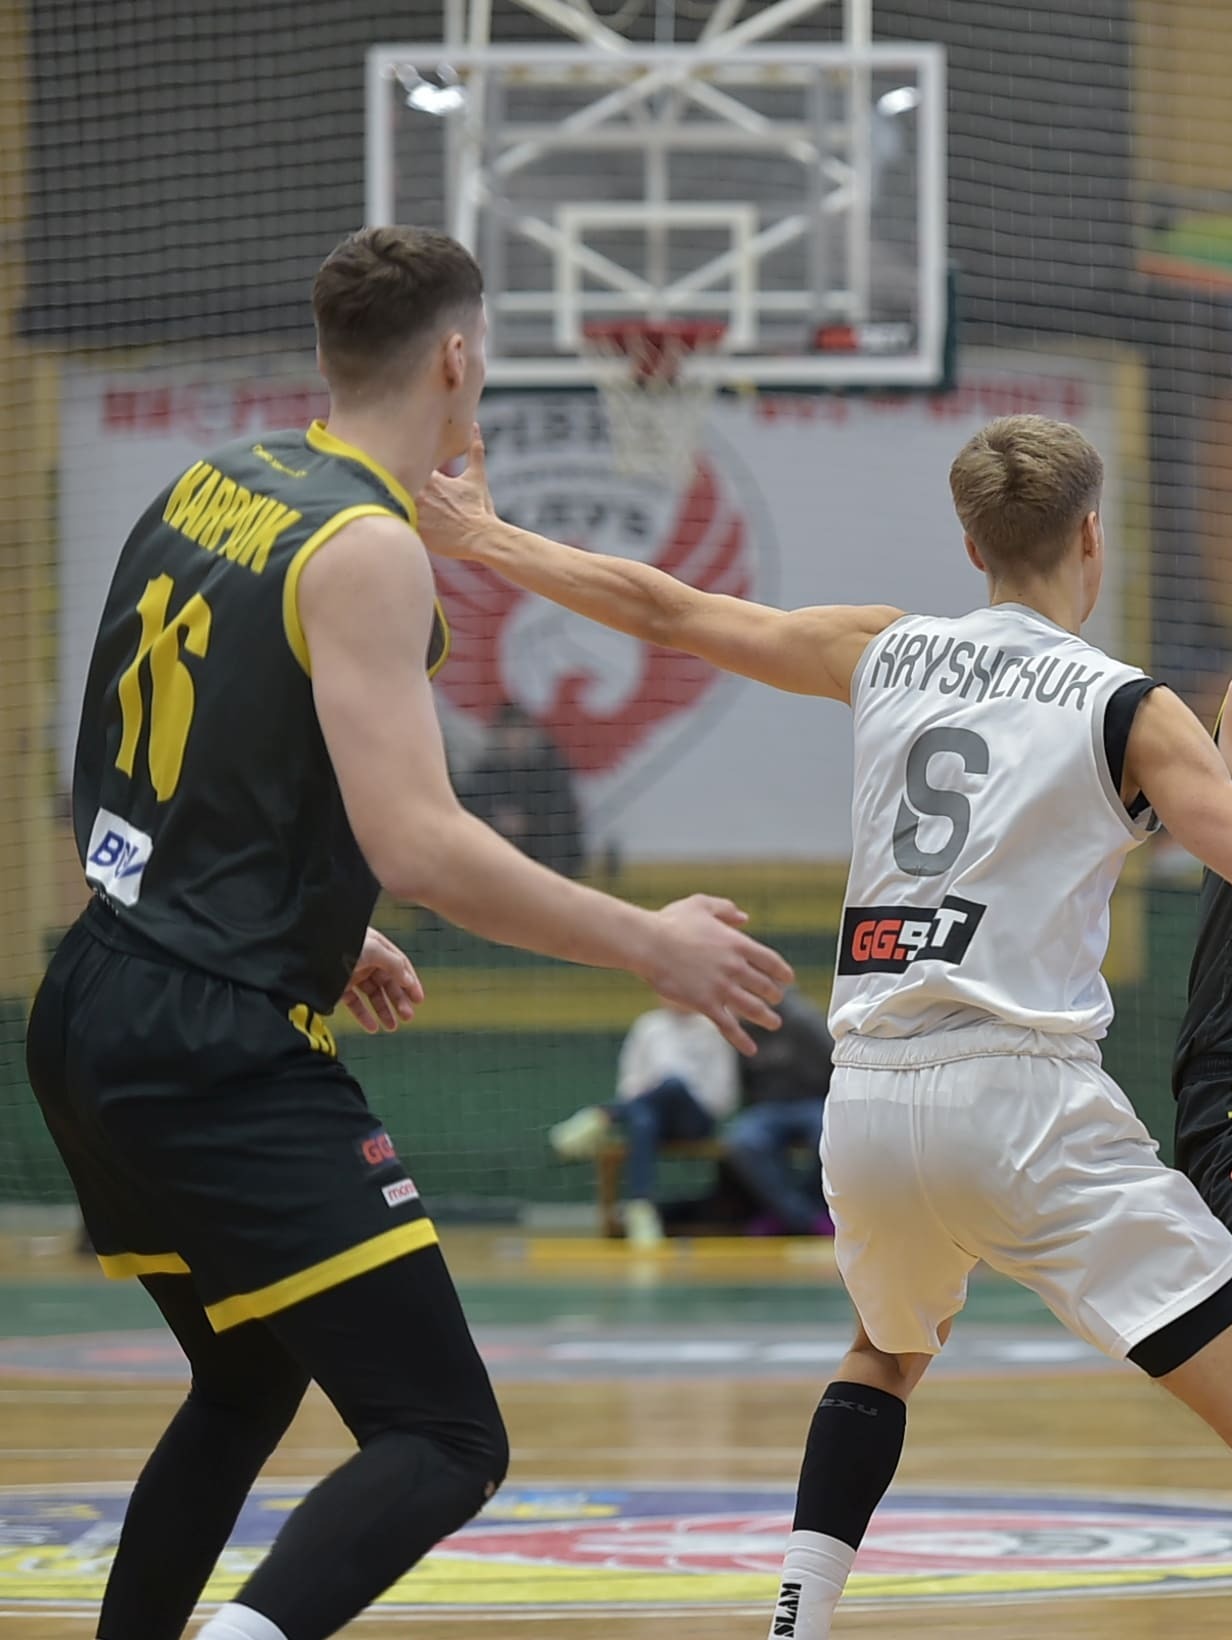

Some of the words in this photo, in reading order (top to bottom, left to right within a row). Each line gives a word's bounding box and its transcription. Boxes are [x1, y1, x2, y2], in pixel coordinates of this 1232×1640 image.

[114, 572, 212, 802] 16
[869, 633, 1104, 712] HRYSHCHUK
[892, 727, 990, 877] 6
[774, 1583, 802, 1639] SLAM
